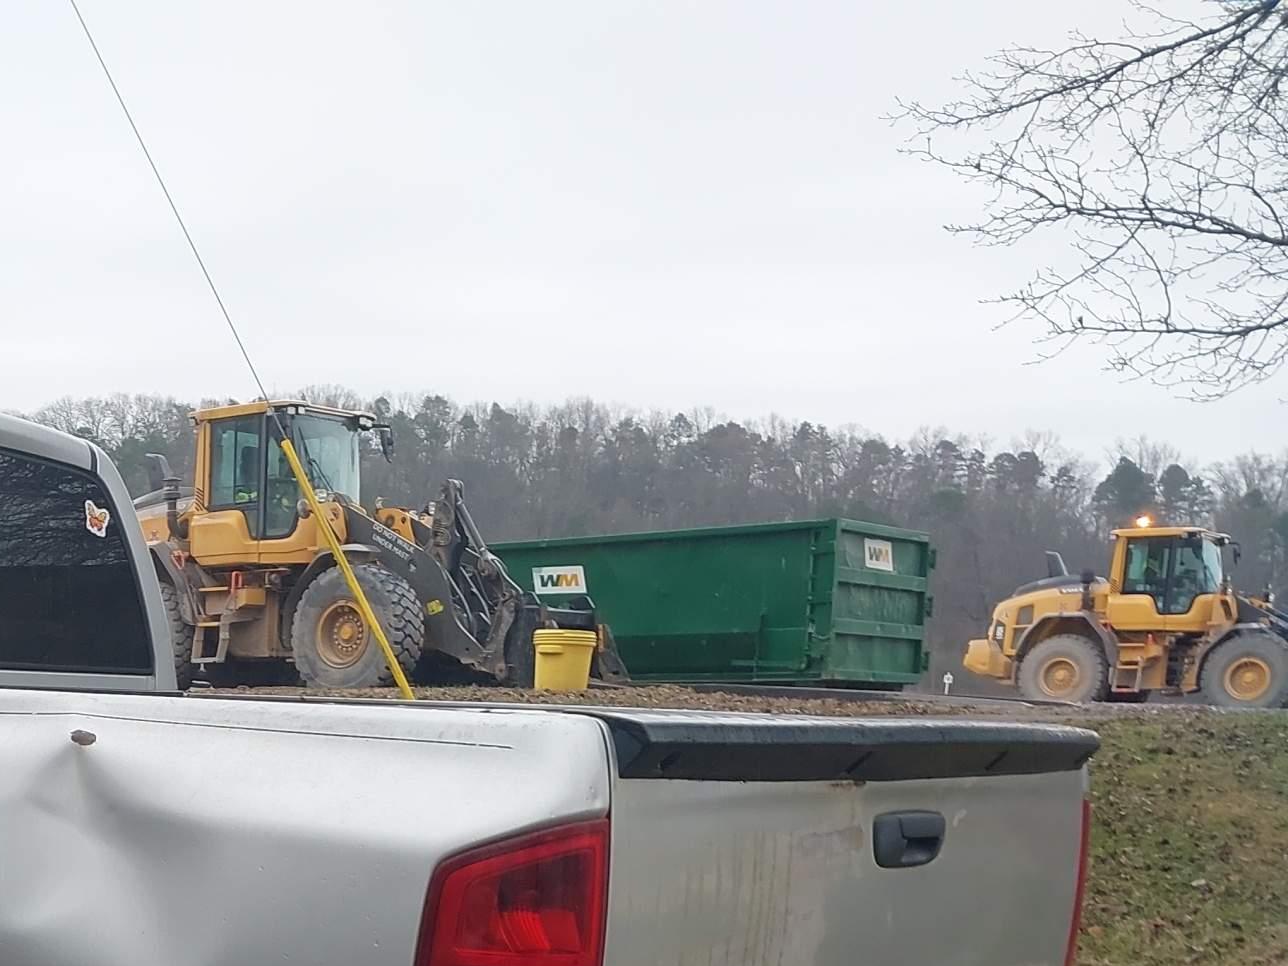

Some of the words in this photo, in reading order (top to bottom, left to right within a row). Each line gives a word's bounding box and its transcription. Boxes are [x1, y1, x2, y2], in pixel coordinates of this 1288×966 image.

[372, 523, 384, 533] DO
[383, 529, 397, 541] NOT
[372, 533, 393, 551] UNDER
[868, 545, 890, 563] WM
[539, 574, 580, 588] WM
